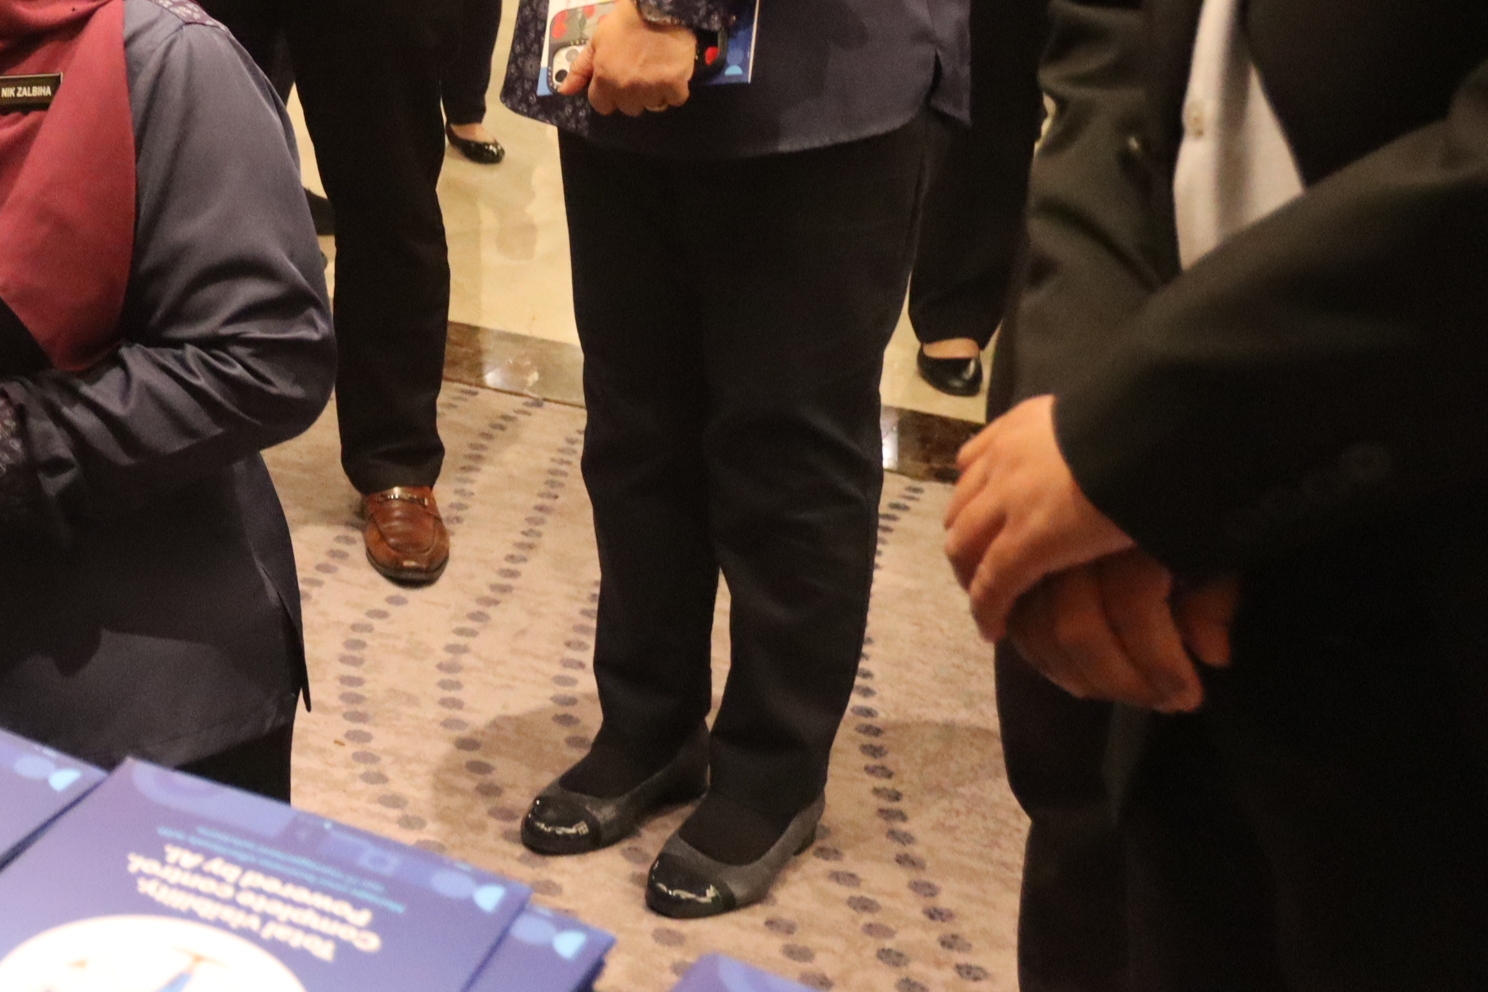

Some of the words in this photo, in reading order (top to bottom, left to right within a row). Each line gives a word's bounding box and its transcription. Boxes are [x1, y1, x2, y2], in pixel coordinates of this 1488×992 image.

[1, 87, 15, 98] NIK
[16, 85, 52, 98] ZALBIHA
[202, 857, 243, 884] by
[239, 869, 373, 927] Powered
[235, 890, 382, 952] Complete
[261, 920, 336, 961] Total
